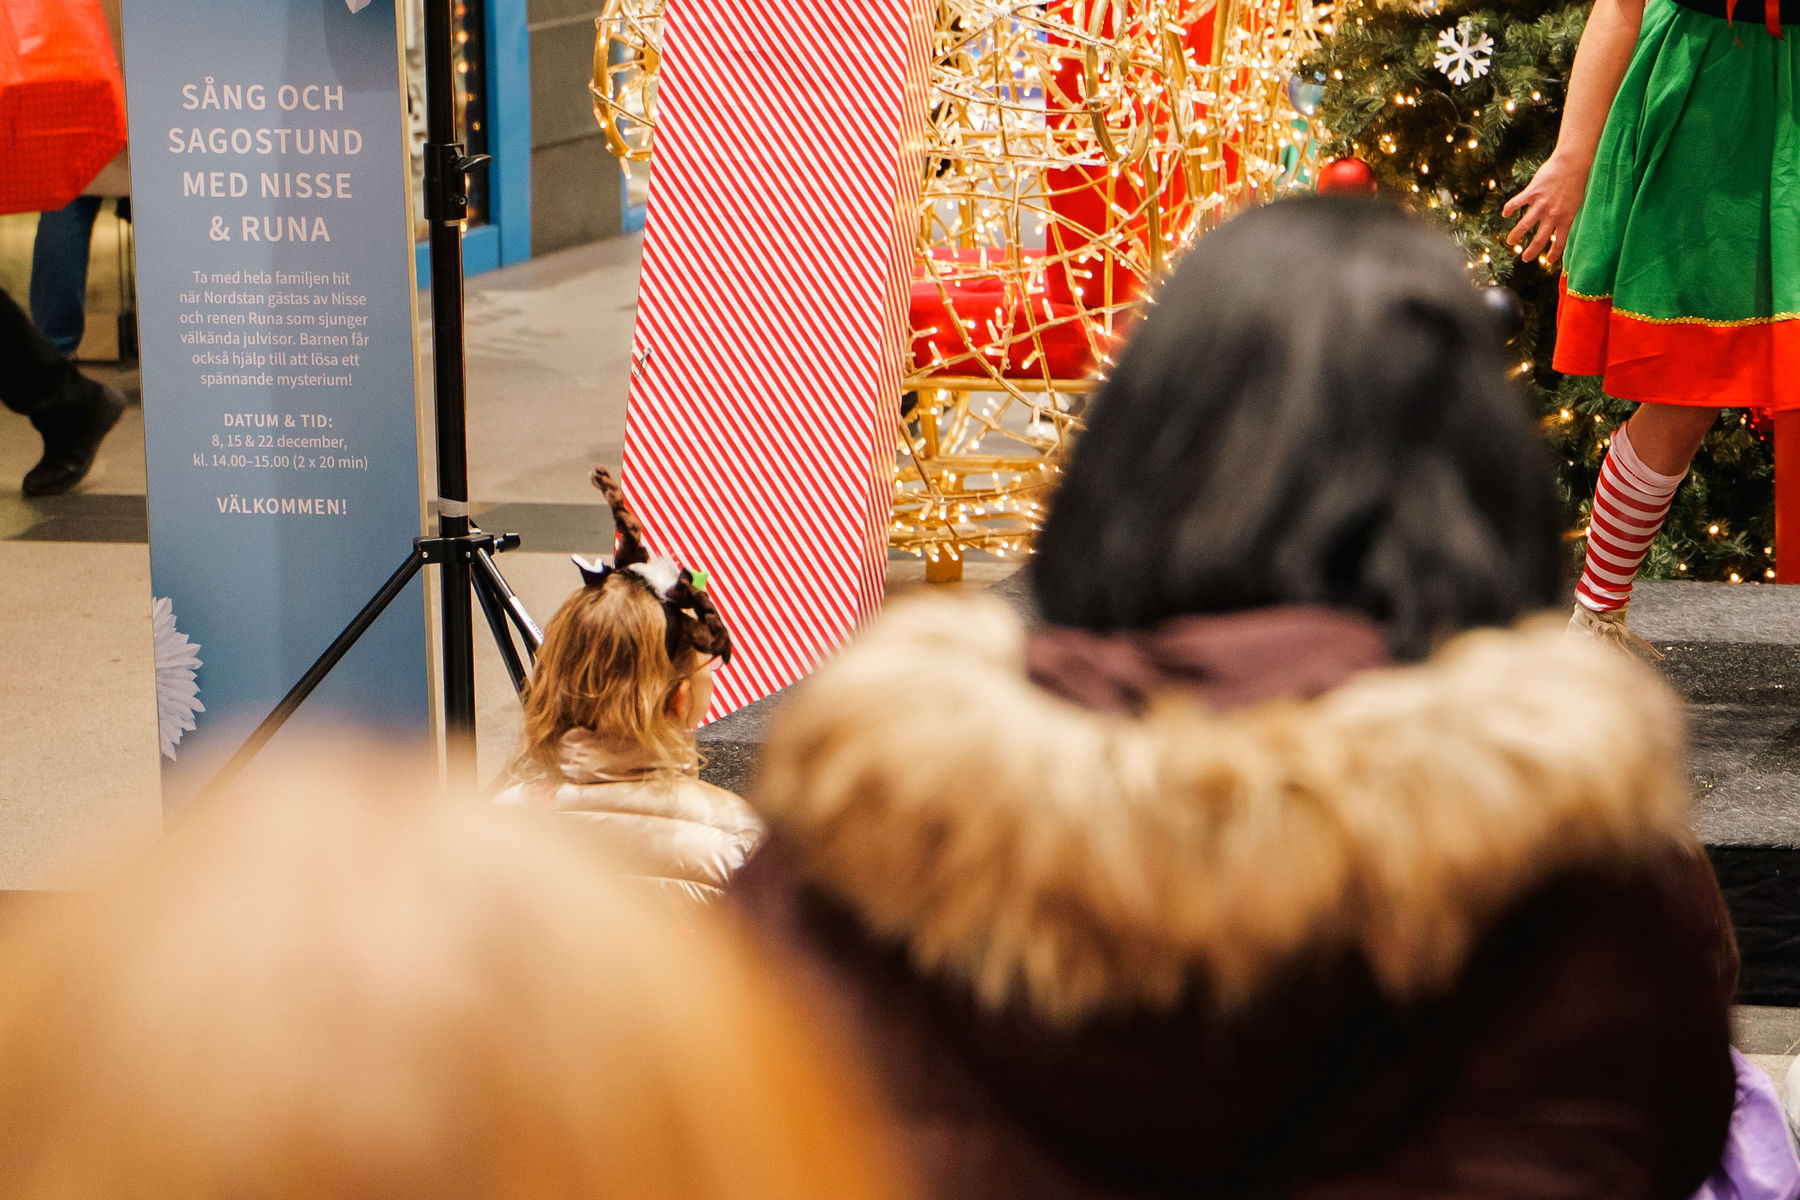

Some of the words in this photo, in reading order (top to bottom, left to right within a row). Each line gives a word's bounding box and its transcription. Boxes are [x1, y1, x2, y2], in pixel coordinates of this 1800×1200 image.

[182, 76, 266, 111] SÅNG
[277, 85, 344, 111] OCH
[168, 128, 363, 155] SAGOSTUND
[183, 171, 248, 198] MED
[260, 173, 353, 199] NISSE
[209, 215, 231, 242] &
[241, 216, 331, 242] RUNA
[192, 270, 208, 284] Ta
[211, 270, 240, 284] med
[244, 270, 272, 284] hela
[276, 270, 329, 288] familjen
[333, 271, 351, 285] hit
[179, 290, 201, 303] när
[204, 291, 264, 305] Nordstan
[268, 292, 310, 308] gästas
[313, 294, 328, 305] av
[331, 292, 367, 305] Nisse
[180, 310, 203, 324] och
[207, 314, 245, 324] renen
[248, 312, 283, 325] Runa
[286, 315, 315, 325] som
[319, 312, 368, 329] sjunger
[180, 331, 240, 345] välkända
[243, 331, 296, 348] julvisor.
[300, 333, 348, 345] Barnen
[351, 332, 370, 346] får
[192, 350, 229, 364] också
[232, 352, 265, 368] hjälp
[269, 352, 286, 366] till
[290, 353, 308, 366] att
[311, 353, 338, 366] lösa
[341, 353, 360, 366] ett
[200, 371, 274, 388] spännande
[277, 373, 353, 389] mysterium!
[224, 413, 279, 427] DATUM
[284, 414, 295, 428] &
[300, 414, 333, 428] TID:
[211, 434, 224, 448] 8,
[227, 435, 242, 447] 15
[245, 434, 255, 447] &
[258, 435, 274, 448] 22
[277, 435, 348, 450] december,
[193, 453, 208, 466] kl.
[293, 455, 305, 470] (2
[309, 458, 316, 468] x
[319, 456, 335, 469] 20
[338, 456, 368, 472] min)
[216, 494, 348, 515] VÄLKOMMEN!
